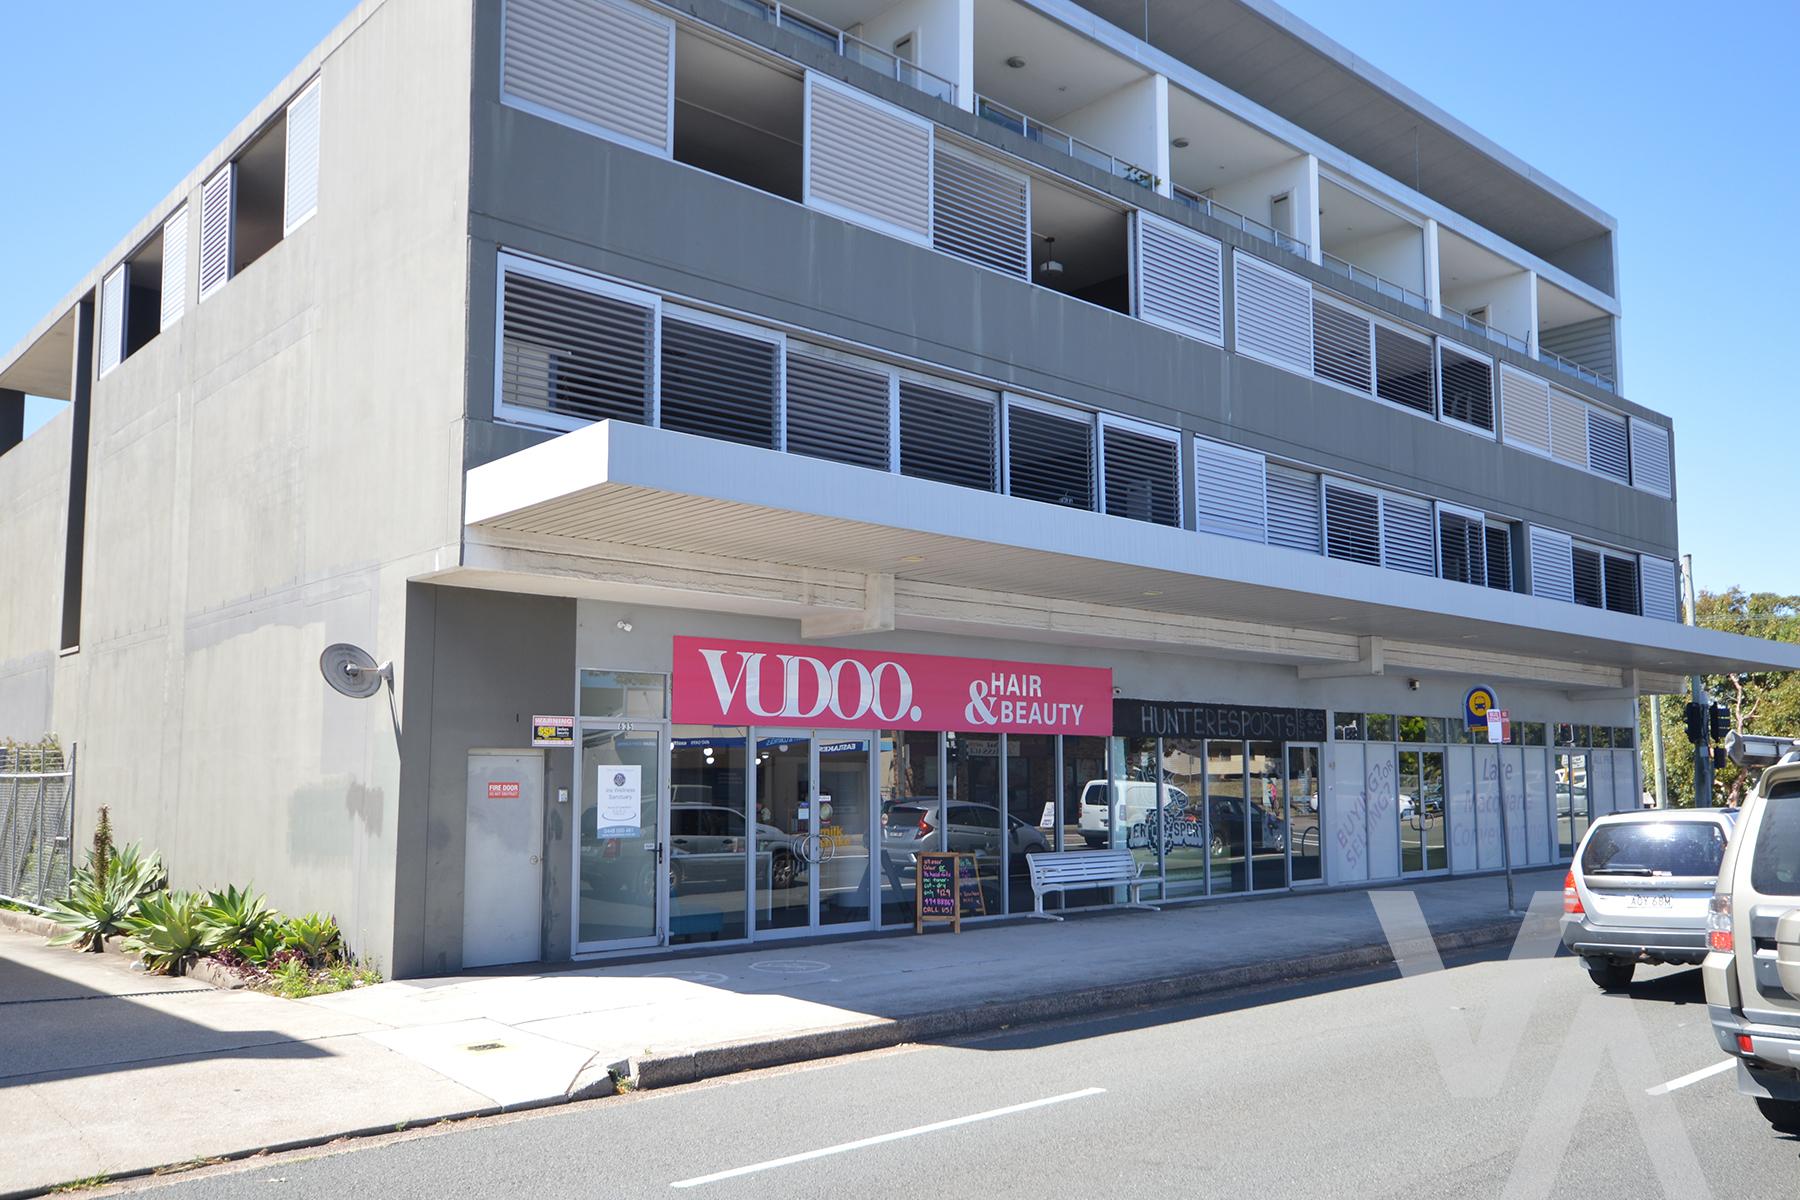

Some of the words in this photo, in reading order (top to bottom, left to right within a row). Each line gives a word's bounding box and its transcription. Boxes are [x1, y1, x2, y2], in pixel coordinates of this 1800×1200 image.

[698, 648, 922, 722] VUDOO.
[964, 679, 999, 726] &
[991, 672, 1042, 698] HAIR
[1000, 700, 1084, 727] BEAUTY
